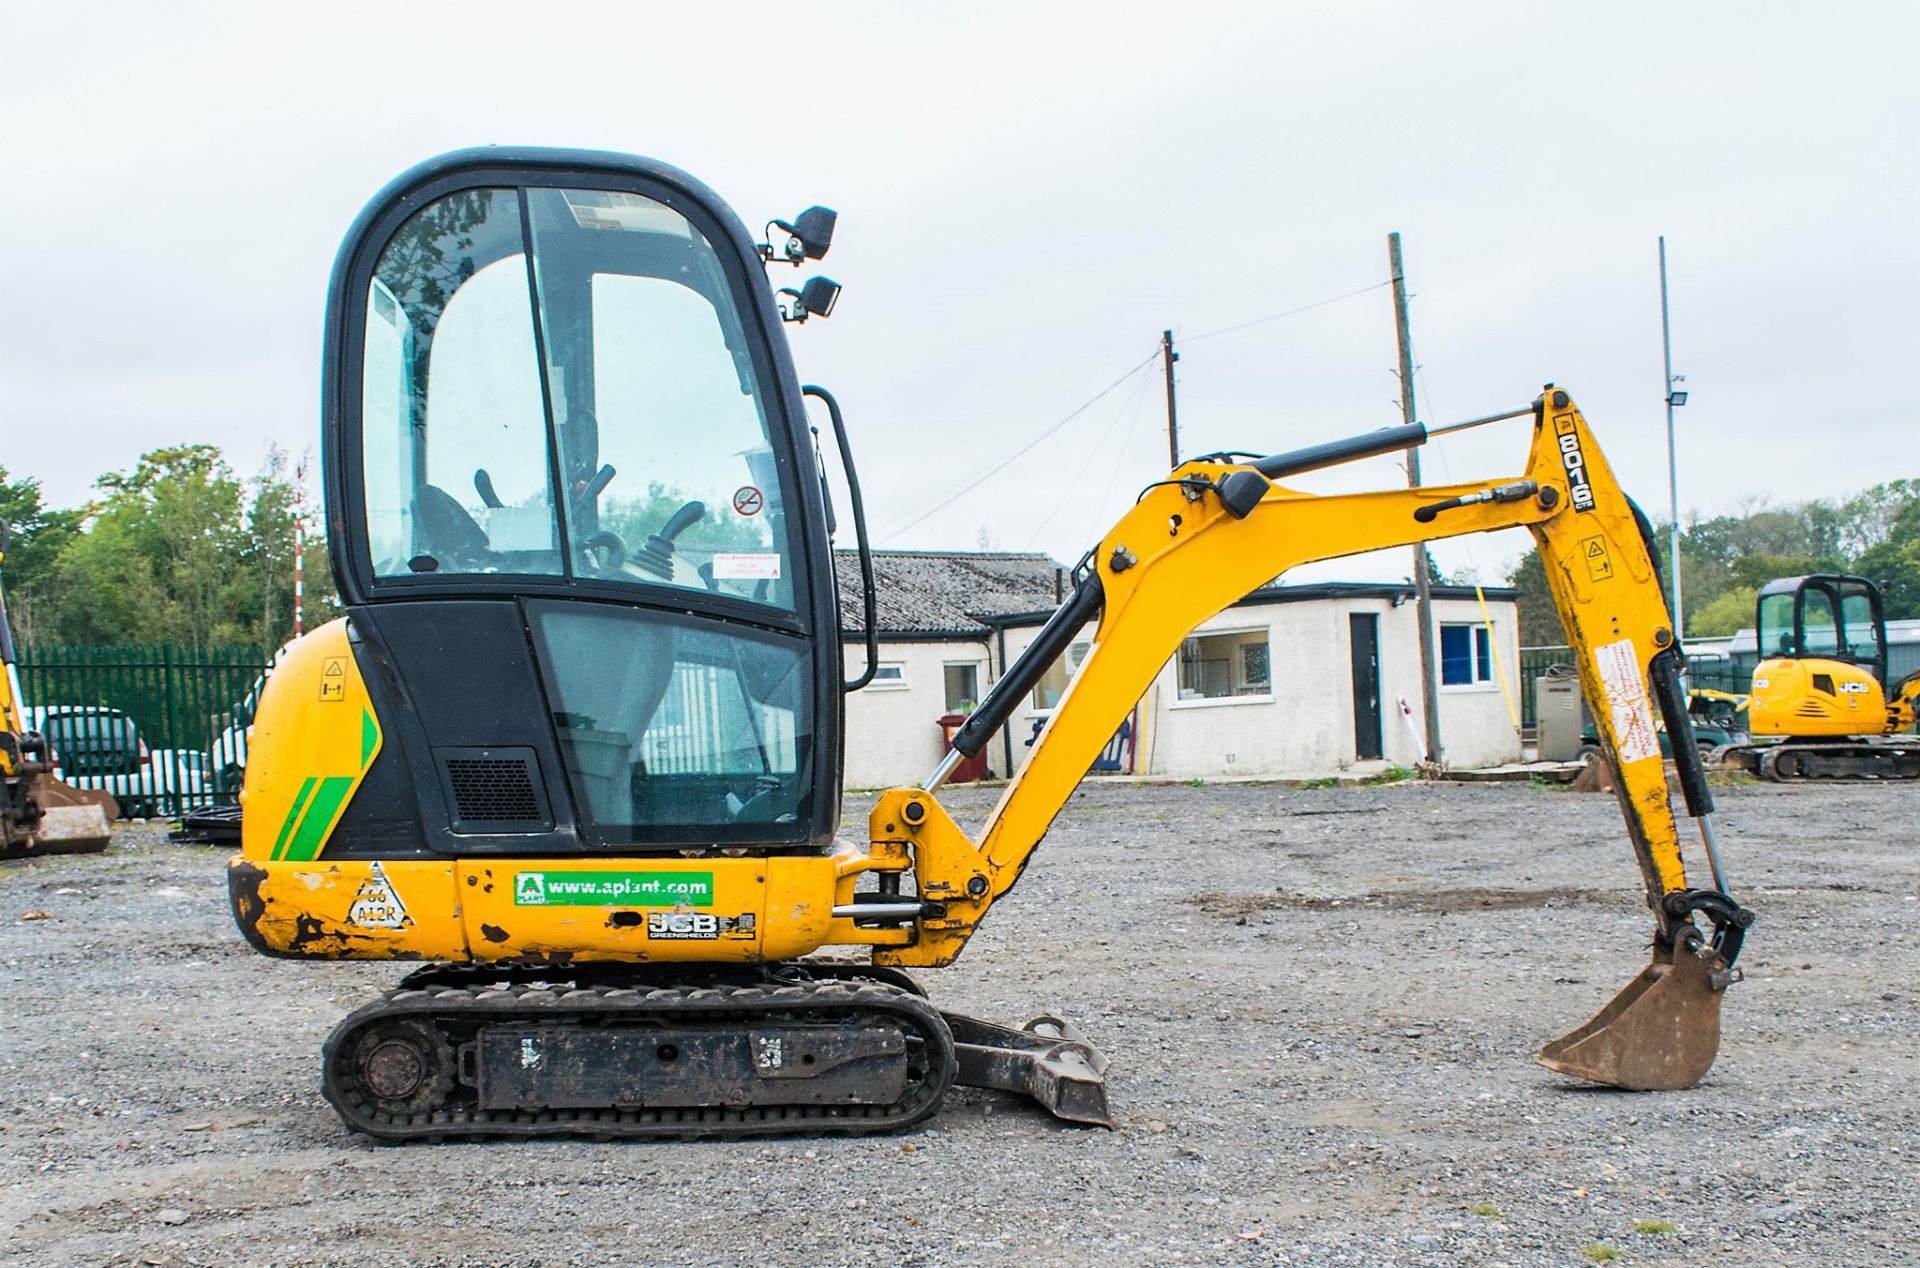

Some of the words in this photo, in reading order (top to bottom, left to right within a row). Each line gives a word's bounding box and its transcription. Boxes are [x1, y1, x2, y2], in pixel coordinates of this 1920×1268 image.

[1559, 434, 1592, 503] 8016
[1838, 681, 1869, 693] JCB
[368, 889, 387, 903] 66
[548, 878, 707, 898] www.aplant.com
[648, 913, 718, 933] JCB
